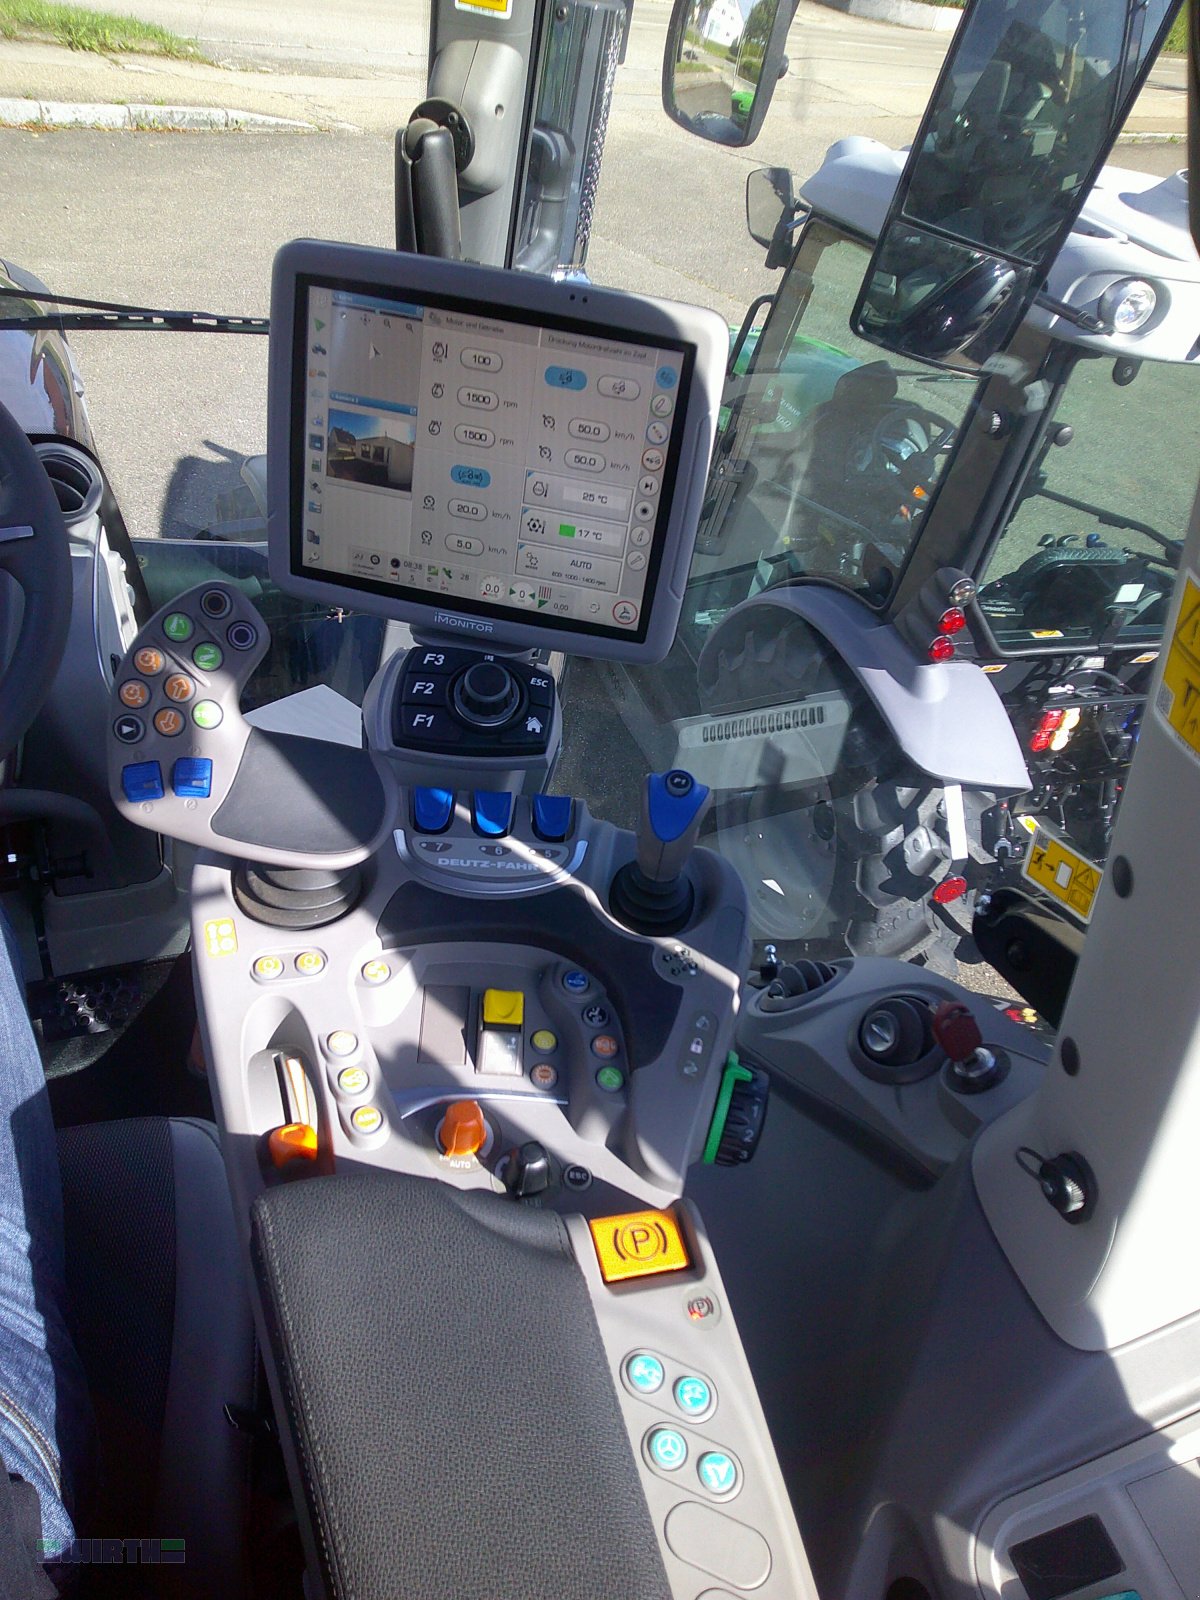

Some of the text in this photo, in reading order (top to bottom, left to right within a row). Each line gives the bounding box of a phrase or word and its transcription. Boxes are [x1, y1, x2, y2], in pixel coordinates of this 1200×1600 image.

[472, 354, 491, 366] 100
[466, 392, 518, 409] 1500 rpm
[463, 429, 514, 446] 1500 rpm
[578, 424, 635, 441] 50.0 km/h
[610, 461, 631, 472] km/h
[582, 492, 595, 502] 25
[457, 504, 511, 520] 20.0 km/h
[578, 529, 590, 538] 17
[456, 540, 508, 555] 5.0 km/h
[570, 559, 592, 570] AUTO
[485, 583, 500, 594] 0.0
[519, 590, 526, 599] 0
[553, 602, 569, 612] 0.00
[423, 652, 445, 666] F3
[412, 681, 435, 695] F2
[530, 677, 549, 688] ESC
[412, 713, 435, 728] F1
[435, 842, 443, 851] 7
[495, 846, 503, 856] 6
[544, 849, 552, 858] 5
[438, 857, 540, 872] DEUTZ-FAHR
[450, 1159, 471, 1169] AUTO
